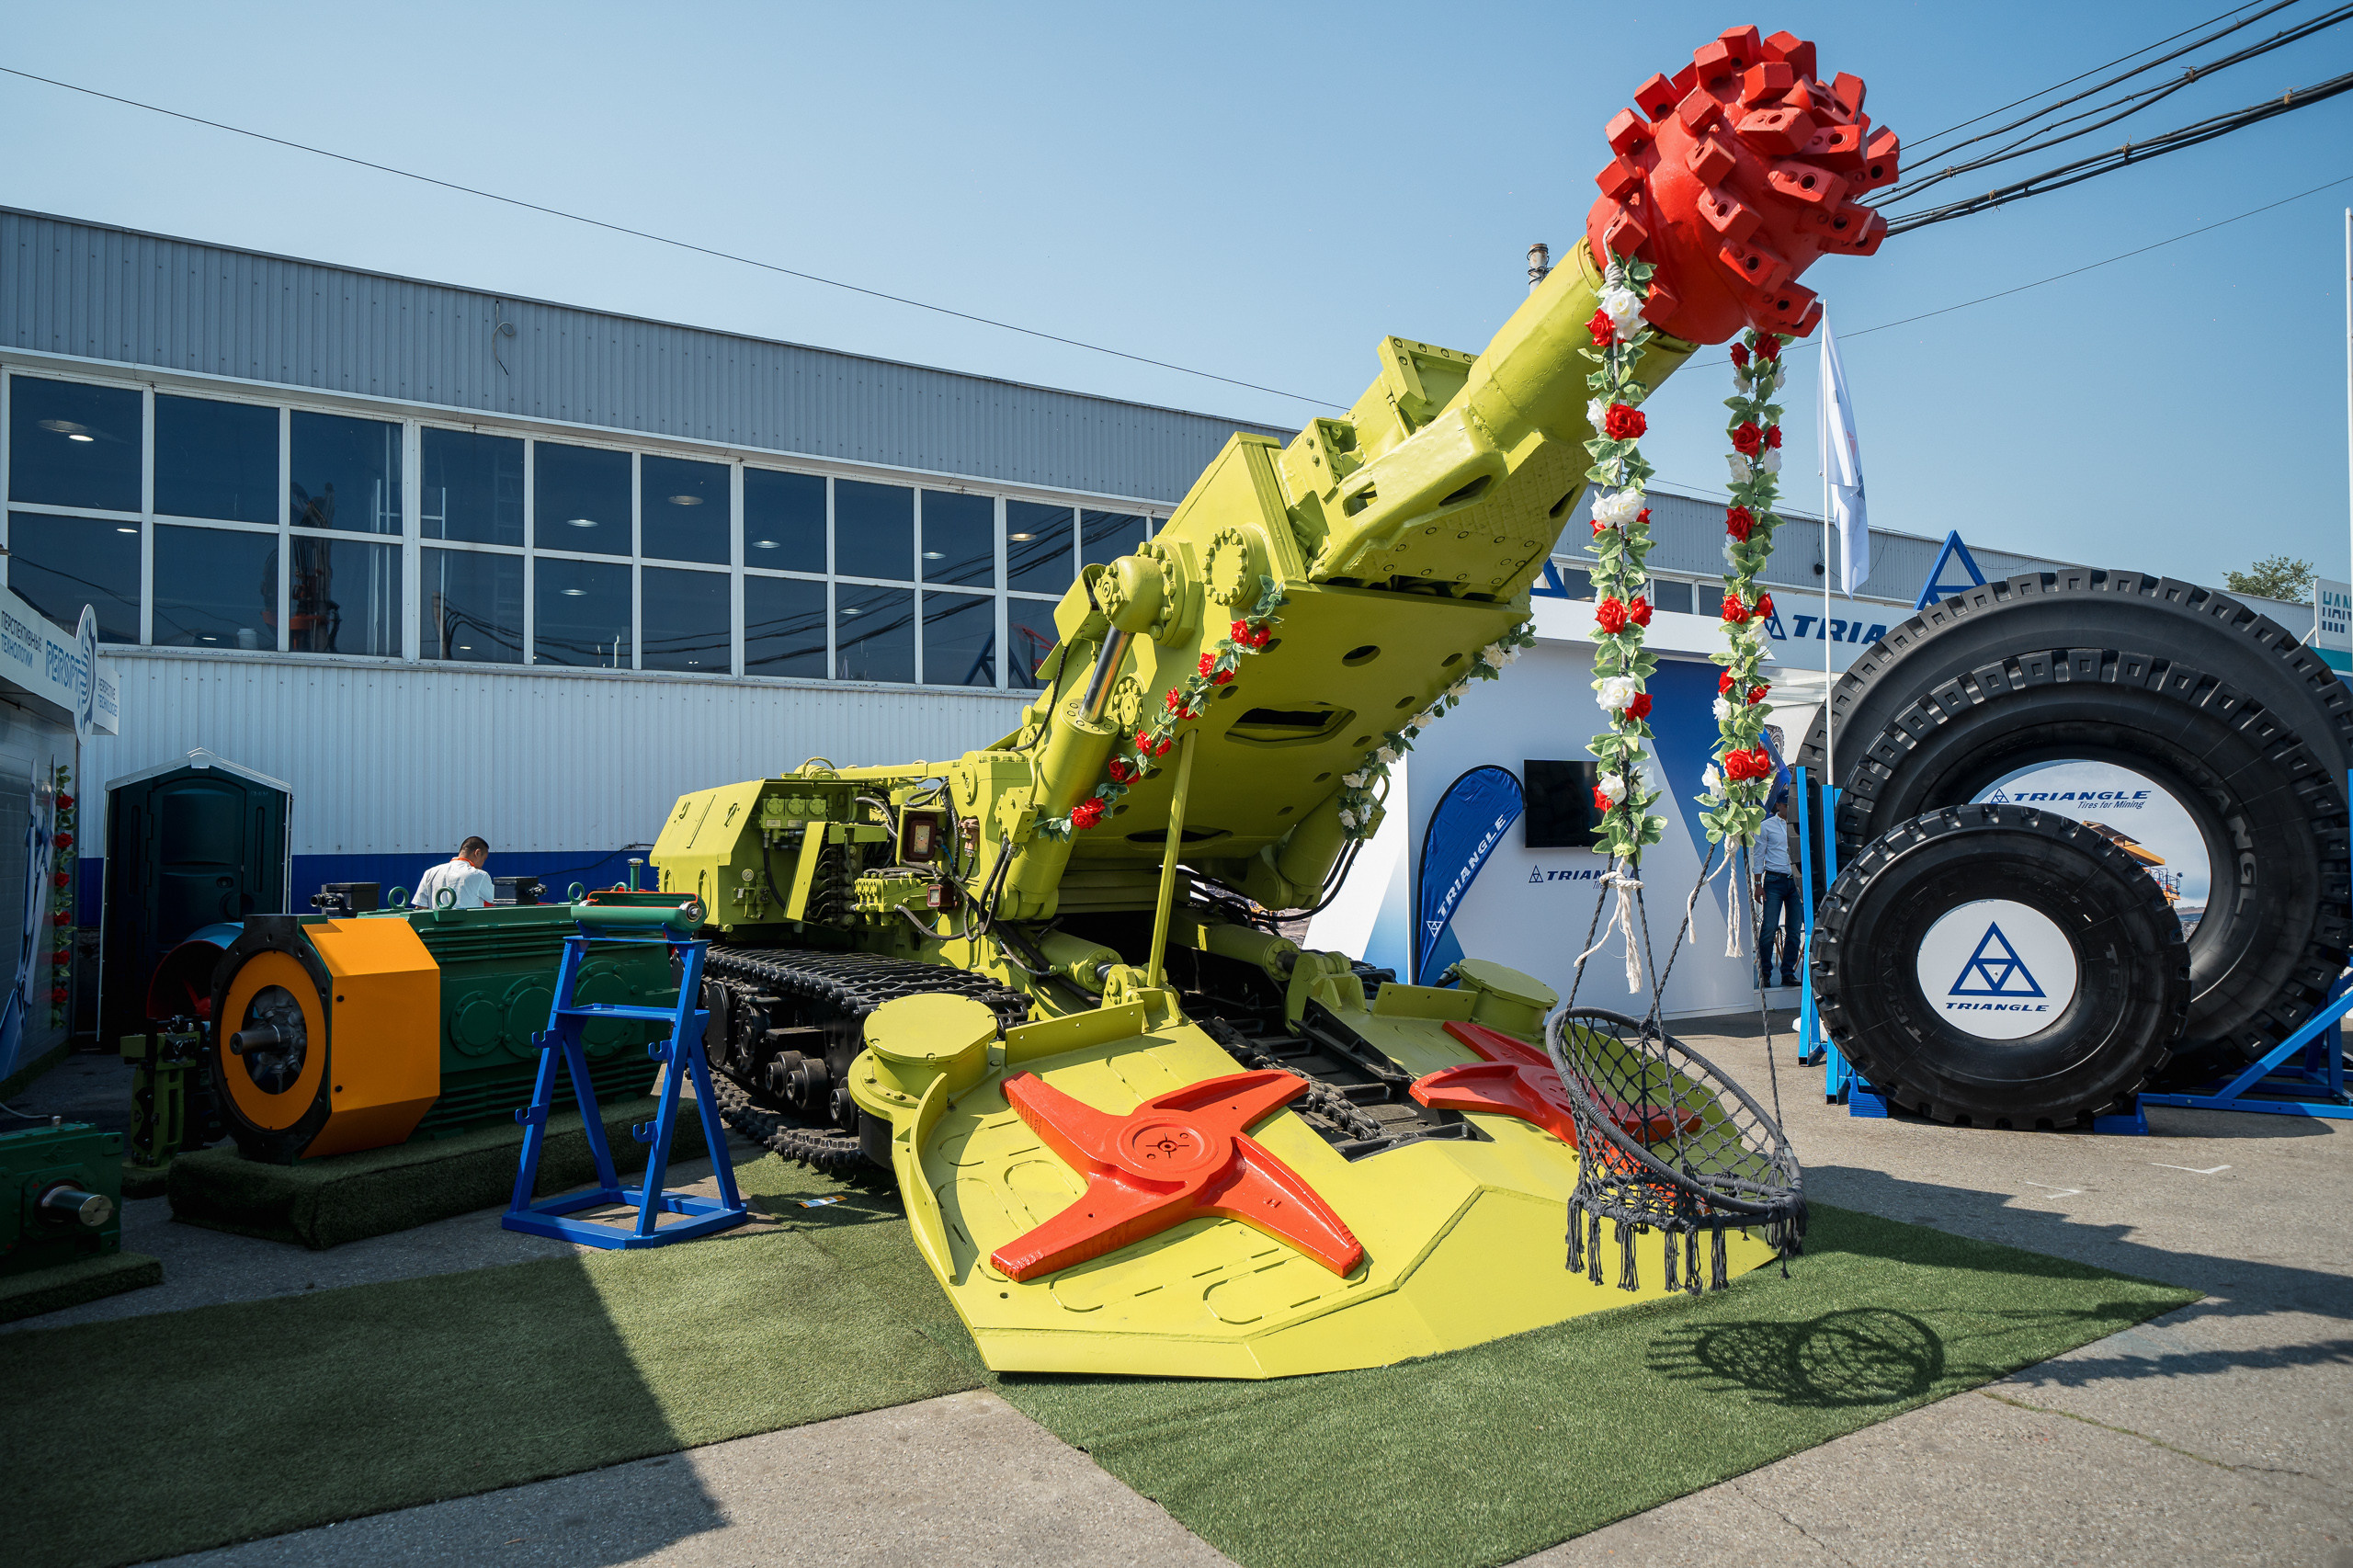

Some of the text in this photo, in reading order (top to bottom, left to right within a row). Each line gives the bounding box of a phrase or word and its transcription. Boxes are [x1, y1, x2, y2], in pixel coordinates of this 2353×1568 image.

[1, 632, 33, 669] ТЕХНОЛОГИИ
[2014, 790, 2152, 802] TRIANGLE
[2077, 801, 2146, 810] Tires for Mining
[1438, 814, 1507, 917] TRIANGLE
[1945, 1002, 2051, 1012] TRIANGLE
